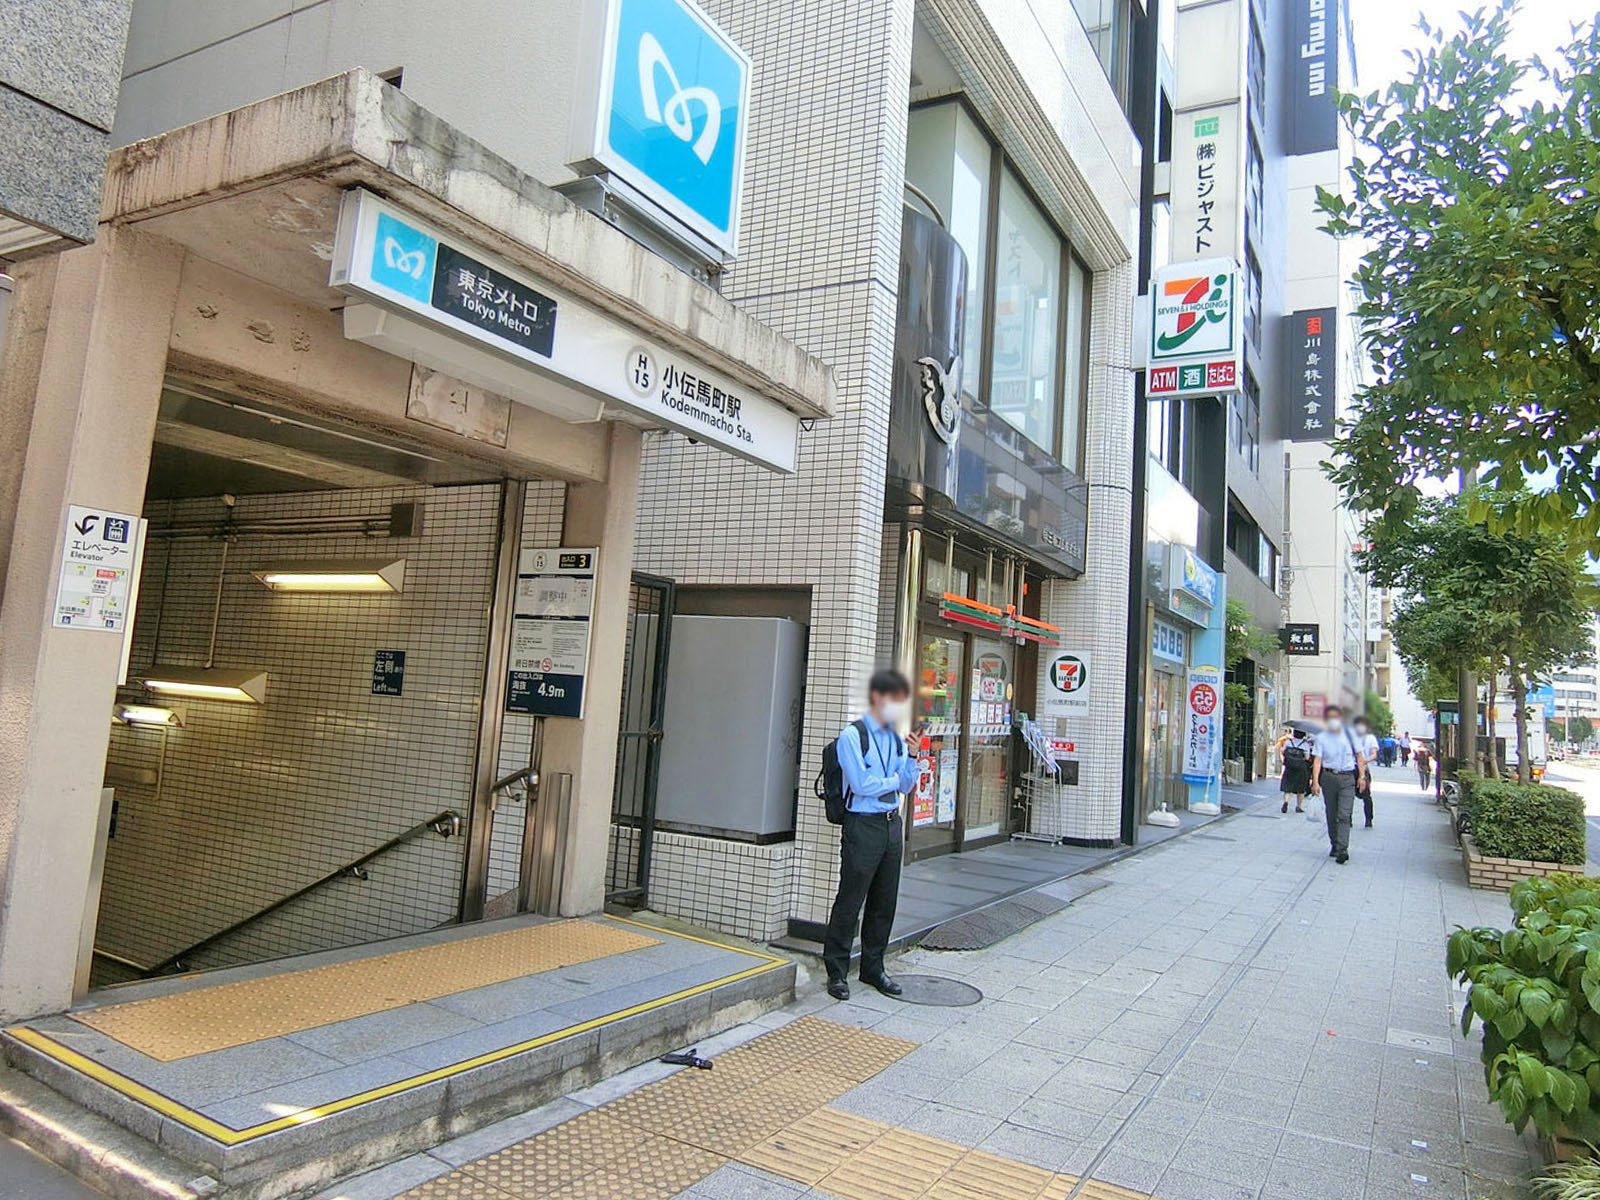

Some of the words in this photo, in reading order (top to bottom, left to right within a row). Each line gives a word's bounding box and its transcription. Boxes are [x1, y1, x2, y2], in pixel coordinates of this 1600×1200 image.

[1309, 61, 1325, 97] inn
[457, 268, 538, 323] 東京メトロ
[461, 292, 496, 322] Tokyo
[498, 309, 532, 337] Metro
[1190, 300, 1229, 313] HOLDINGS
[638, 353, 648, 369] H
[634, 369, 650, 390] 15
[1152, 371, 1177, 389] ATM
[1184, 368, 1202, 387] 酒
[1208, 365, 1235, 384] たばこ
[662, 363, 742, 421] 小伝馬町駅
[660, 390, 734, 438] Kodemmacho
[735, 424, 755, 444] Sta.
[70, 551, 104, 561] Elevator
[71, 539, 130, 556] エレベーター
[578, 554, 587, 568] 3
[375, 660, 395, 674] 左側
[373, 683, 387, 693] Left
[536, 681, 565, 699] 4.9m
